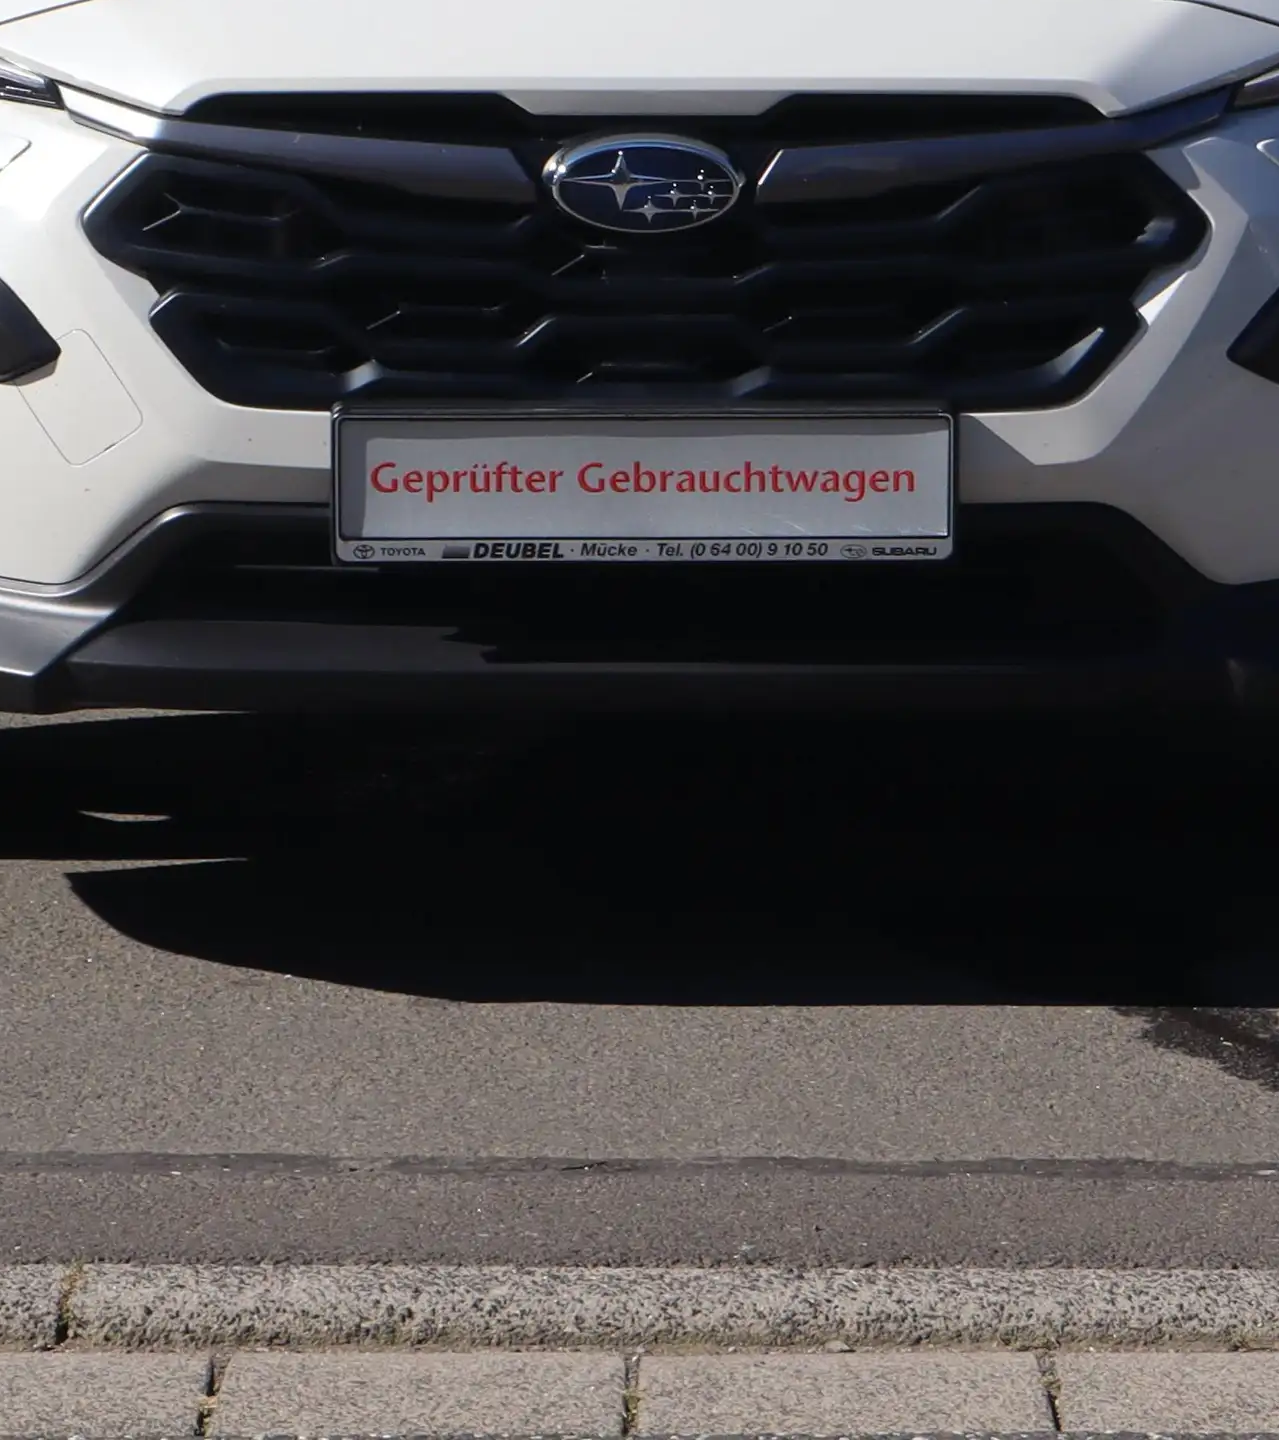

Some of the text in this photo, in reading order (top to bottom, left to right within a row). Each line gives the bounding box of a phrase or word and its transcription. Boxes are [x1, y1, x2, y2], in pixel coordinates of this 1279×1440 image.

[369, 461, 917, 503] Geprüfter Gebrauchtwagen
[380, 547, 427, 557] TOYOTA
[472, 542, 566, 560] DEUBEL
[579, 542, 638, 558] Mücke
[657, 542, 684, 558] Tel.
[710, 542, 731, 557] 64
[736, 542, 763, 559] 00)
[766, 542, 779, 557] 9
[783, 542, 803, 557] 10
[806, 542, 829, 557] 50
[871, 546, 938, 557] SUBARU
